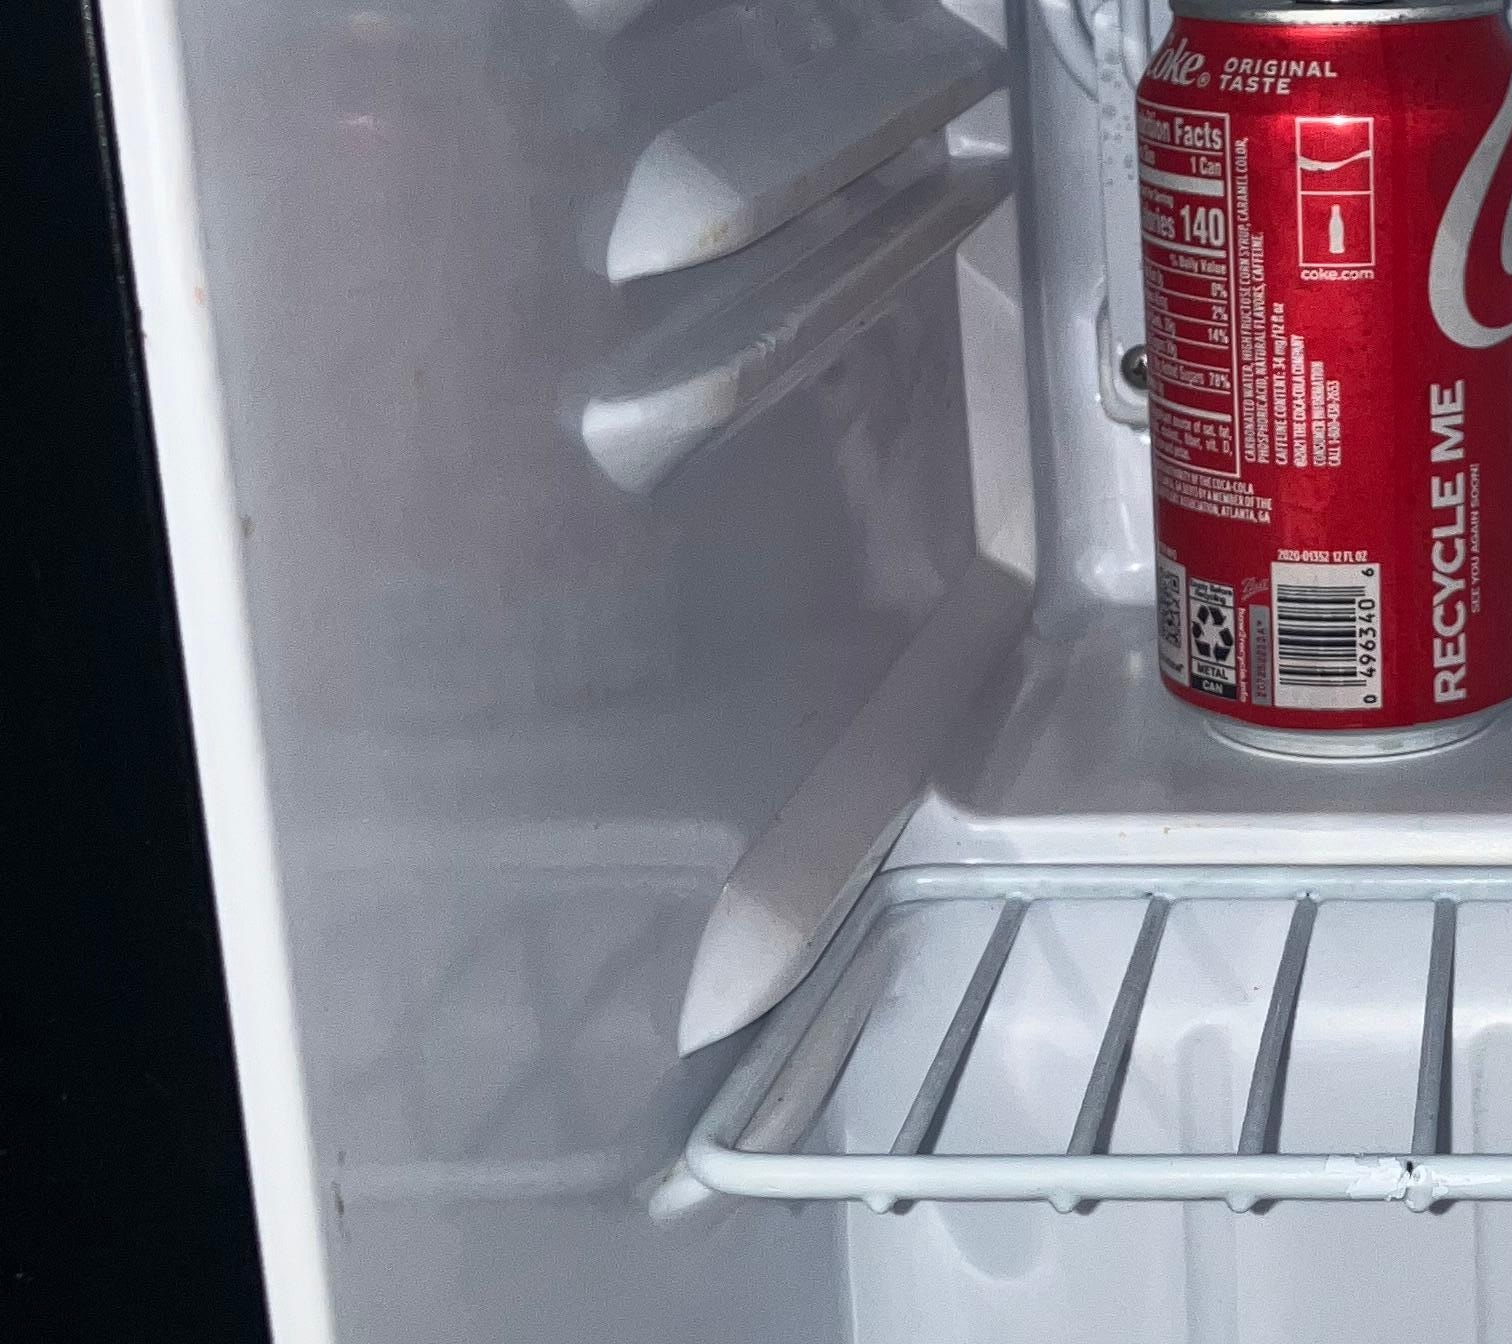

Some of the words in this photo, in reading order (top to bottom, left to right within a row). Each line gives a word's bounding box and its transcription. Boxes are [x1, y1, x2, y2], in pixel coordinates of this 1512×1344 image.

[1223, 56, 1338, 78] ORIGINAL
[1219, 74, 1292, 96] TASTE
[1173, 116, 1223, 150] Facts
[1189, 155, 1198, 174] 1
[1199, 155, 1222, 176] Can
[1180, 204, 1225, 247] 140
[1301, 268, 1375, 281] coke.com
[1430, 379, 1466, 463] ME
[1212, 478, 1254, 495] COCA-COLA
[1469, 463, 1480, 509] SOON!
[1469, 511, 1480, 554] AGAIN
[1342, 550, 1353, 563] FL
[1355, 550, 1369, 563] OZ
[1362, 567, 1375, 577] 6
[1470, 556, 1481, 585] YOU
[1431, 471, 1468, 704] RECYCLE
[1470, 585, 1481, 614] SEE
[1358, 598, 1377, 678] 496340
[1197, 662, 1229, 681] METAL
[1202, 679, 1224, 694] CAN
[1363, 694, 1378, 704] 0
